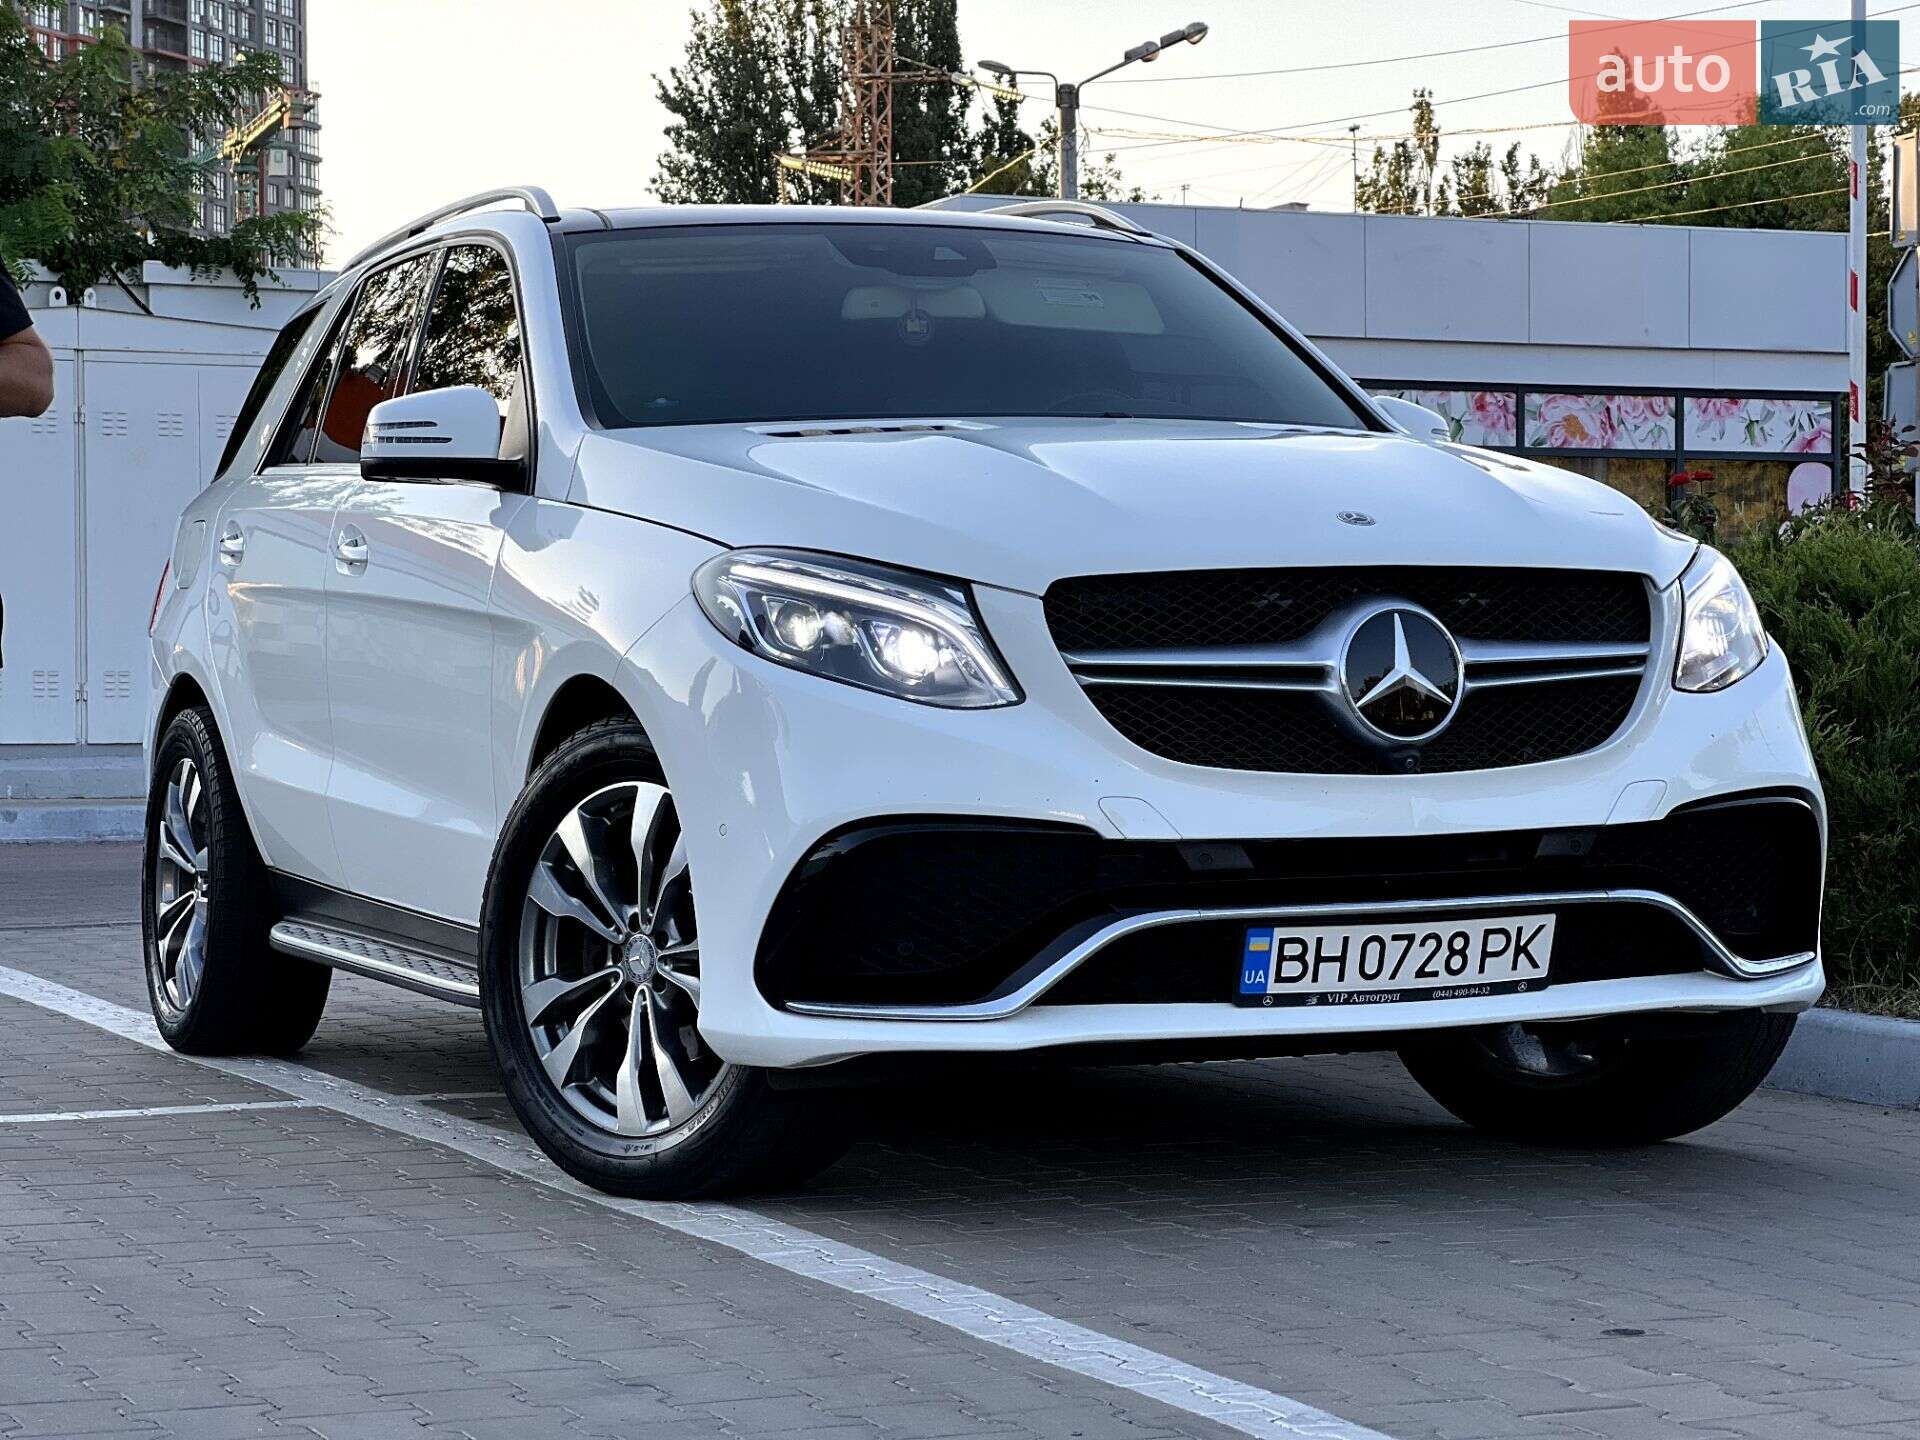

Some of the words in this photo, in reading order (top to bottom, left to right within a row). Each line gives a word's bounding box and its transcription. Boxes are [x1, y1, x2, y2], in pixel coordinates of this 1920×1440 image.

[1273, 935, 1350, 984] BH
[1357, 930, 1470, 981] 0728
[1477, 923, 1547, 975] PK
[1244, 969, 1266, 985] UA
[1327, 993, 1348, 1003] VIP
